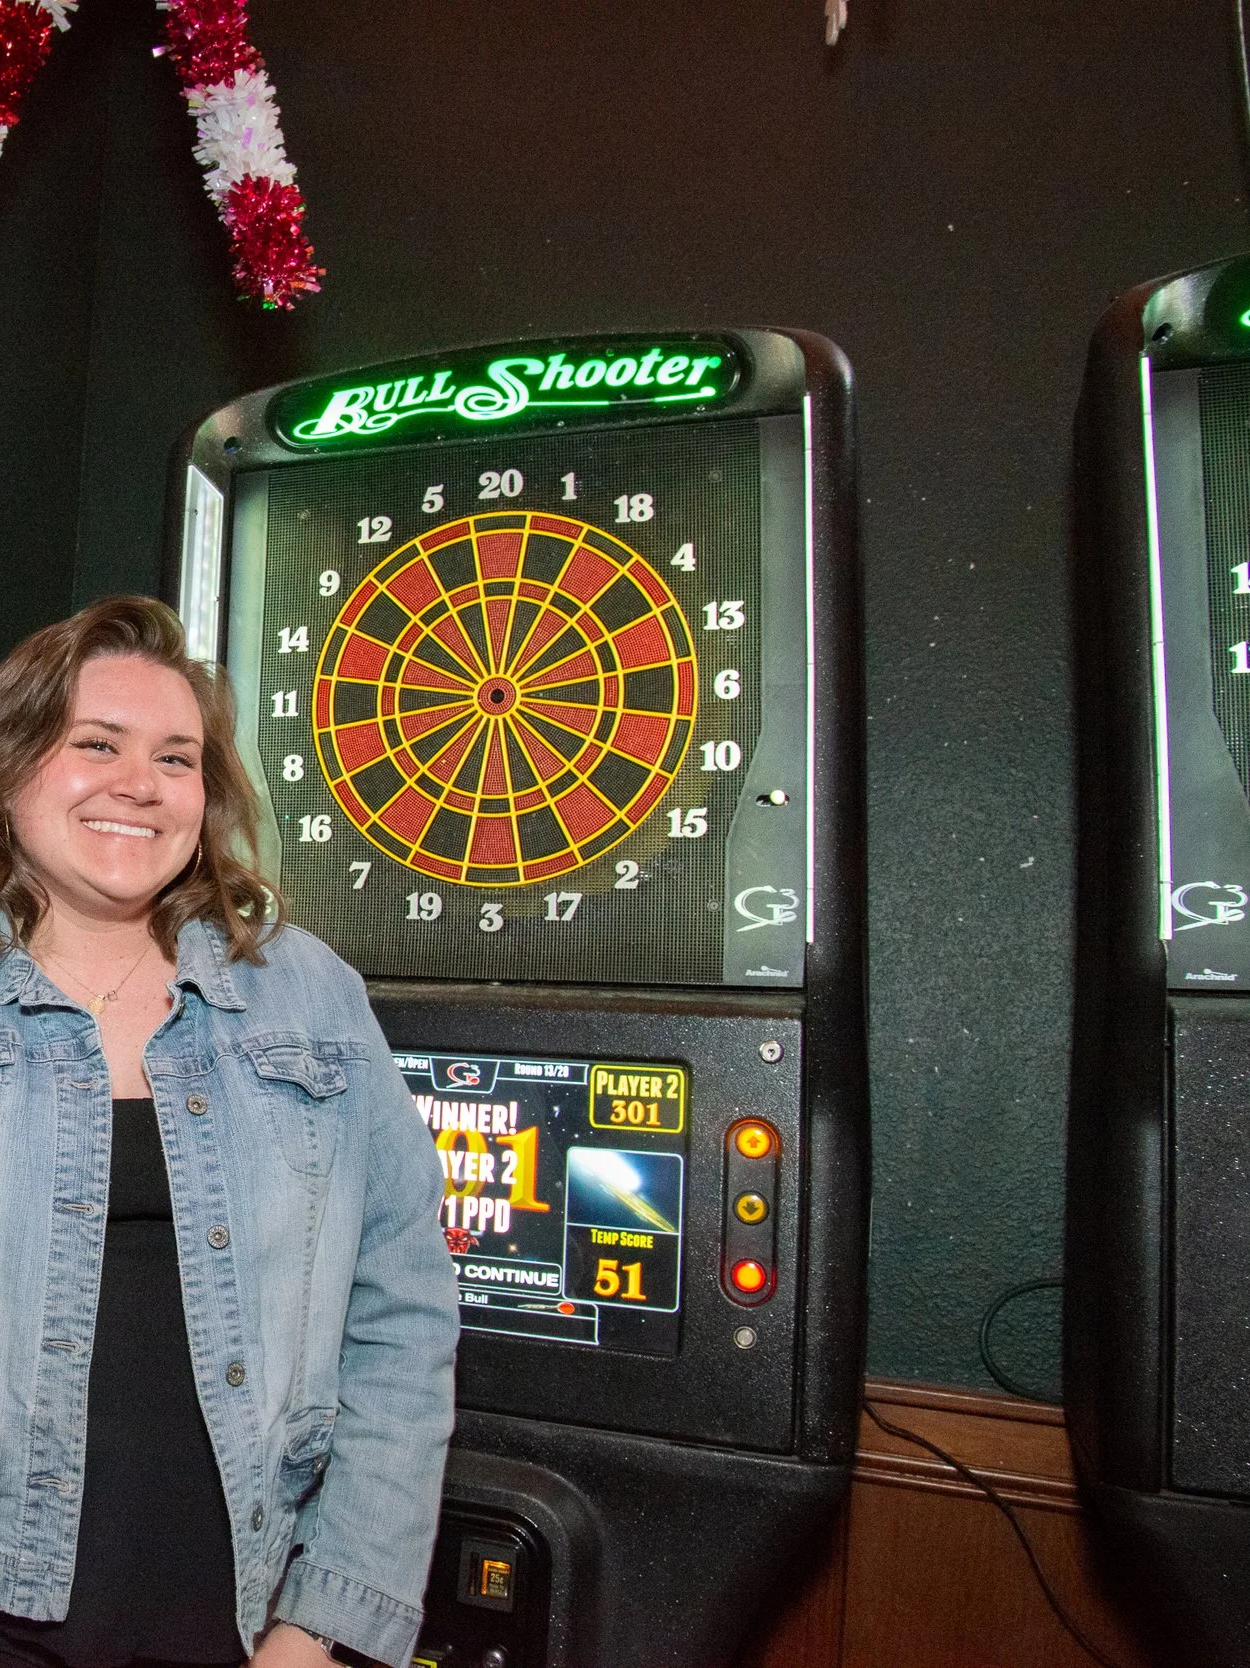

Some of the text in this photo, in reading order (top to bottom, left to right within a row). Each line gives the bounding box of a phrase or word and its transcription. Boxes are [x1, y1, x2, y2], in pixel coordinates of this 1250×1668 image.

[293, 348, 722, 439] BULL Shooter
[479, 468, 523, 498] 20
[560, 473, 579, 500] 1
[421, 485, 444, 512] 5
[614, 494, 654, 522] 18
[356, 517, 392, 543] 12
[671, 543, 696, 570] 4
[319, 571, 340, 596] 9
[1230, 561, 1250, 594] 1
[702, 601, 744, 630] 13
[277, 627, 309, 653] 14
[1229, 641, 1250, 673] 1
[714, 670, 740, 698] 6
[271, 692, 298, 717] 11
[282, 756, 303, 781] 8
[699, 742, 741, 771] 10
[298, 816, 332, 842] 16
[667, 808, 707, 838] 15
[350, 863, 372, 889] 7
[615, 861, 639, 889] 2
[406, 892, 441, 921] 19
[479, 903, 503, 932] 3
[544, 892, 581, 921] 17
[596, 1070, 678, 1099] PLAYER 2
[610, 1099, 661, 1126] 301
[437, 1149, 518, 1184] AYER 2
[462, 1195, 510, 1233] PPD
[590, 1228, 654, 1249] TEMP SCORE
[464, 1264, 559, 1288] CONTINUE
[593, 1258, 647, 1300] 51
[465, 1293, 488, 1304] Bull
